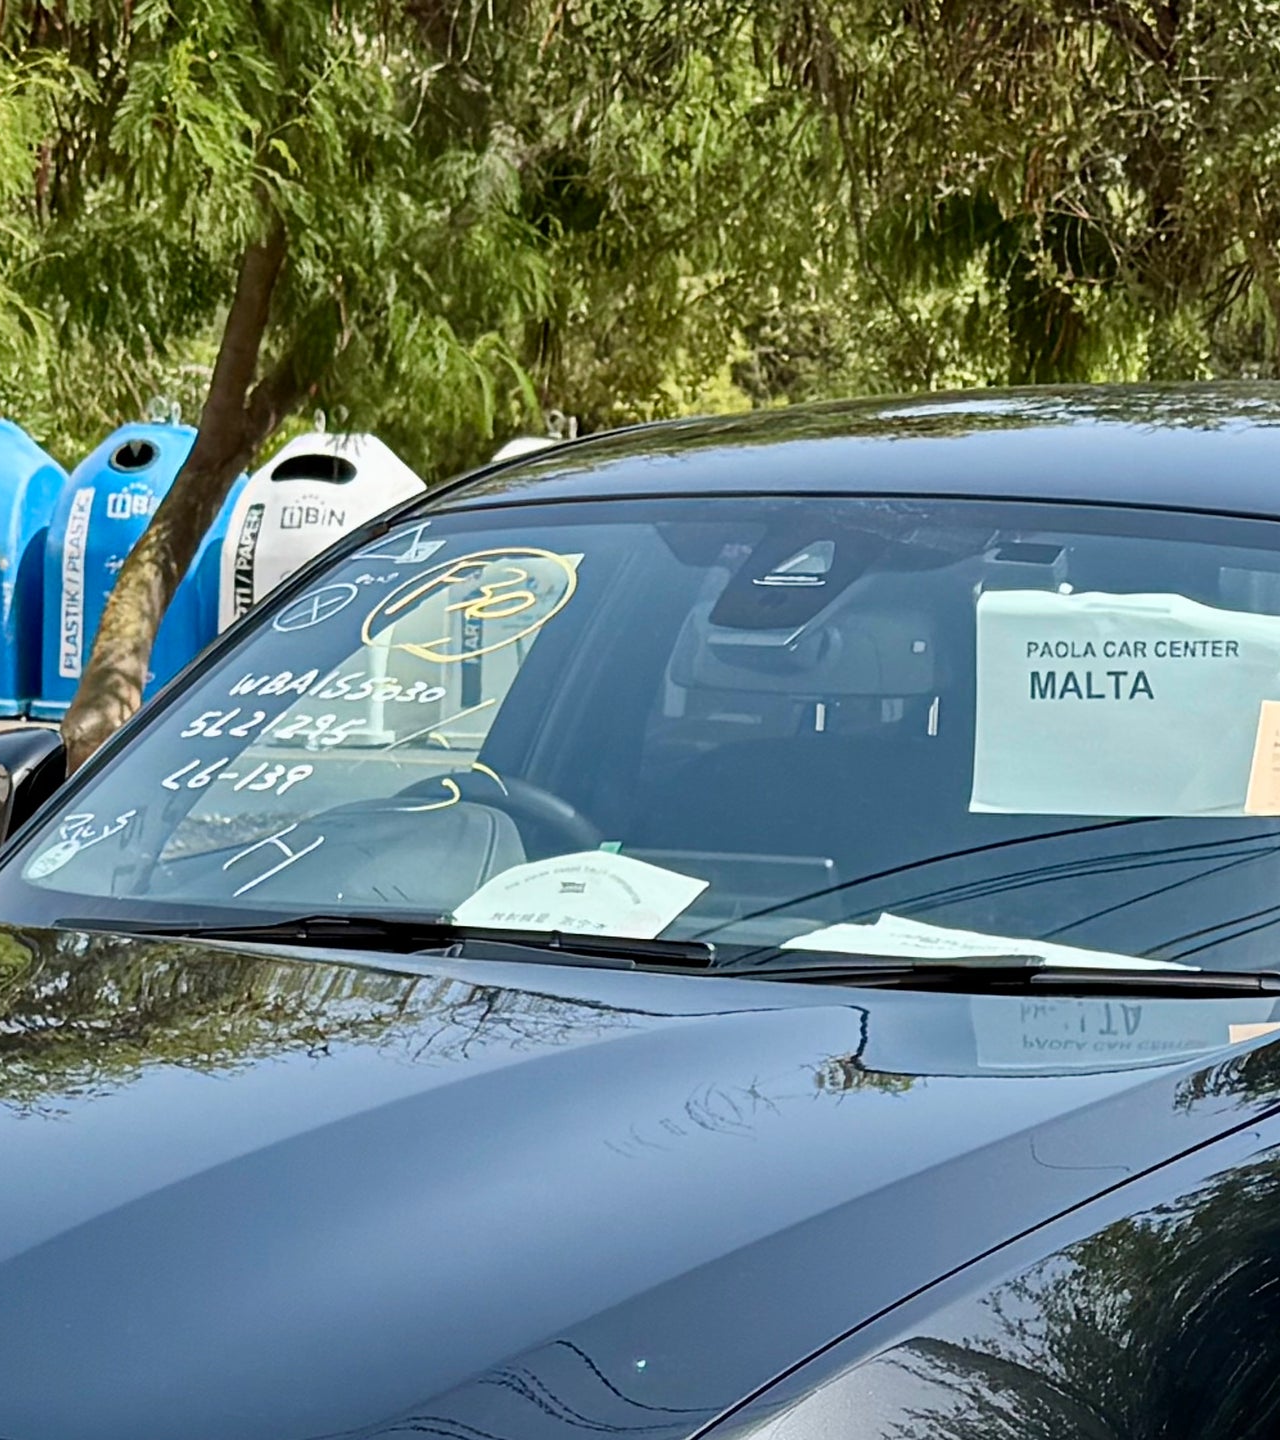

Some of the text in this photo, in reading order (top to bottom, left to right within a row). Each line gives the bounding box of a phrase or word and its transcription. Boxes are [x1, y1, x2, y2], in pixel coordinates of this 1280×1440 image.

[235, 508, 263, 570] PAPER
[64, 590, 80, 670] PLASTIK
[1027, 640, 1240, 658] PAOLA CAR CENTER
[1030, 670, 1154, 700] MALTA
